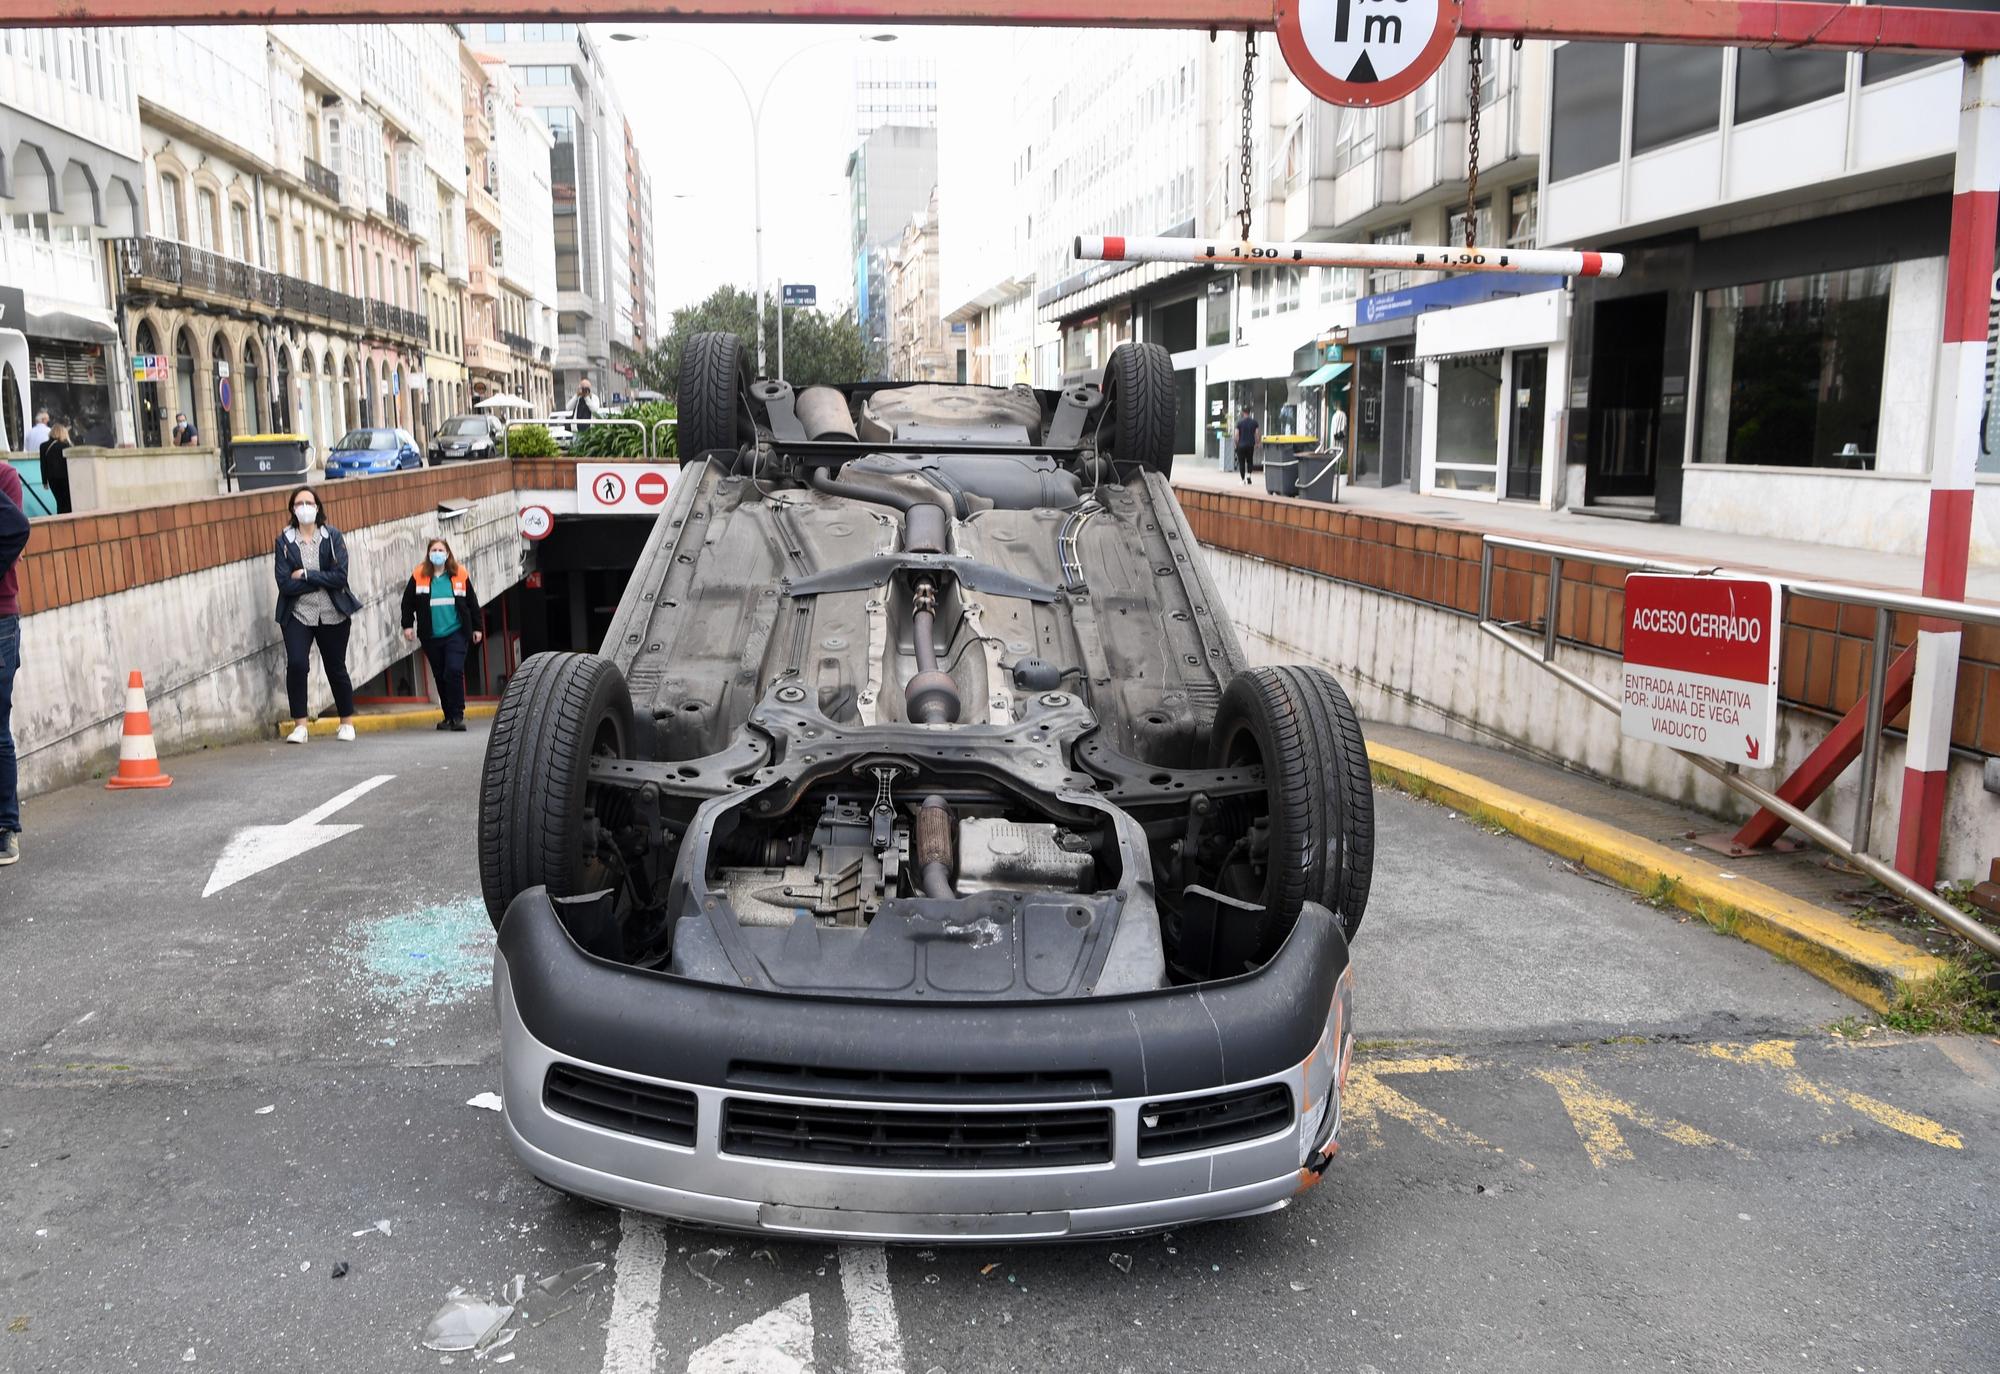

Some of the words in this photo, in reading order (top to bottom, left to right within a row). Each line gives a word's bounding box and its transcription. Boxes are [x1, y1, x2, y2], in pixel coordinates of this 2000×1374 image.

[1363, 14, 1402, 44] m
[1230, 246, 1279, 260] 1,90
[1438, 253, 1487, 266] 1,90
[1632, 607, 1687, 635] ACCESO
[1690, 612, 1761, 644] CERRADO
[1625, 673, 1674, 696] ENTRADA
[1676, 682, 1752, 710] ALTERNATIVA
[1624, 690, 1649, 708] POR:
[1651, 695, 1688, 715] JUANA
[1690, 701, 1706, 719] DE
[1708, 705, 1740, 726] VEGA
[1651, 717, 1707, 743] VIADUCTO
